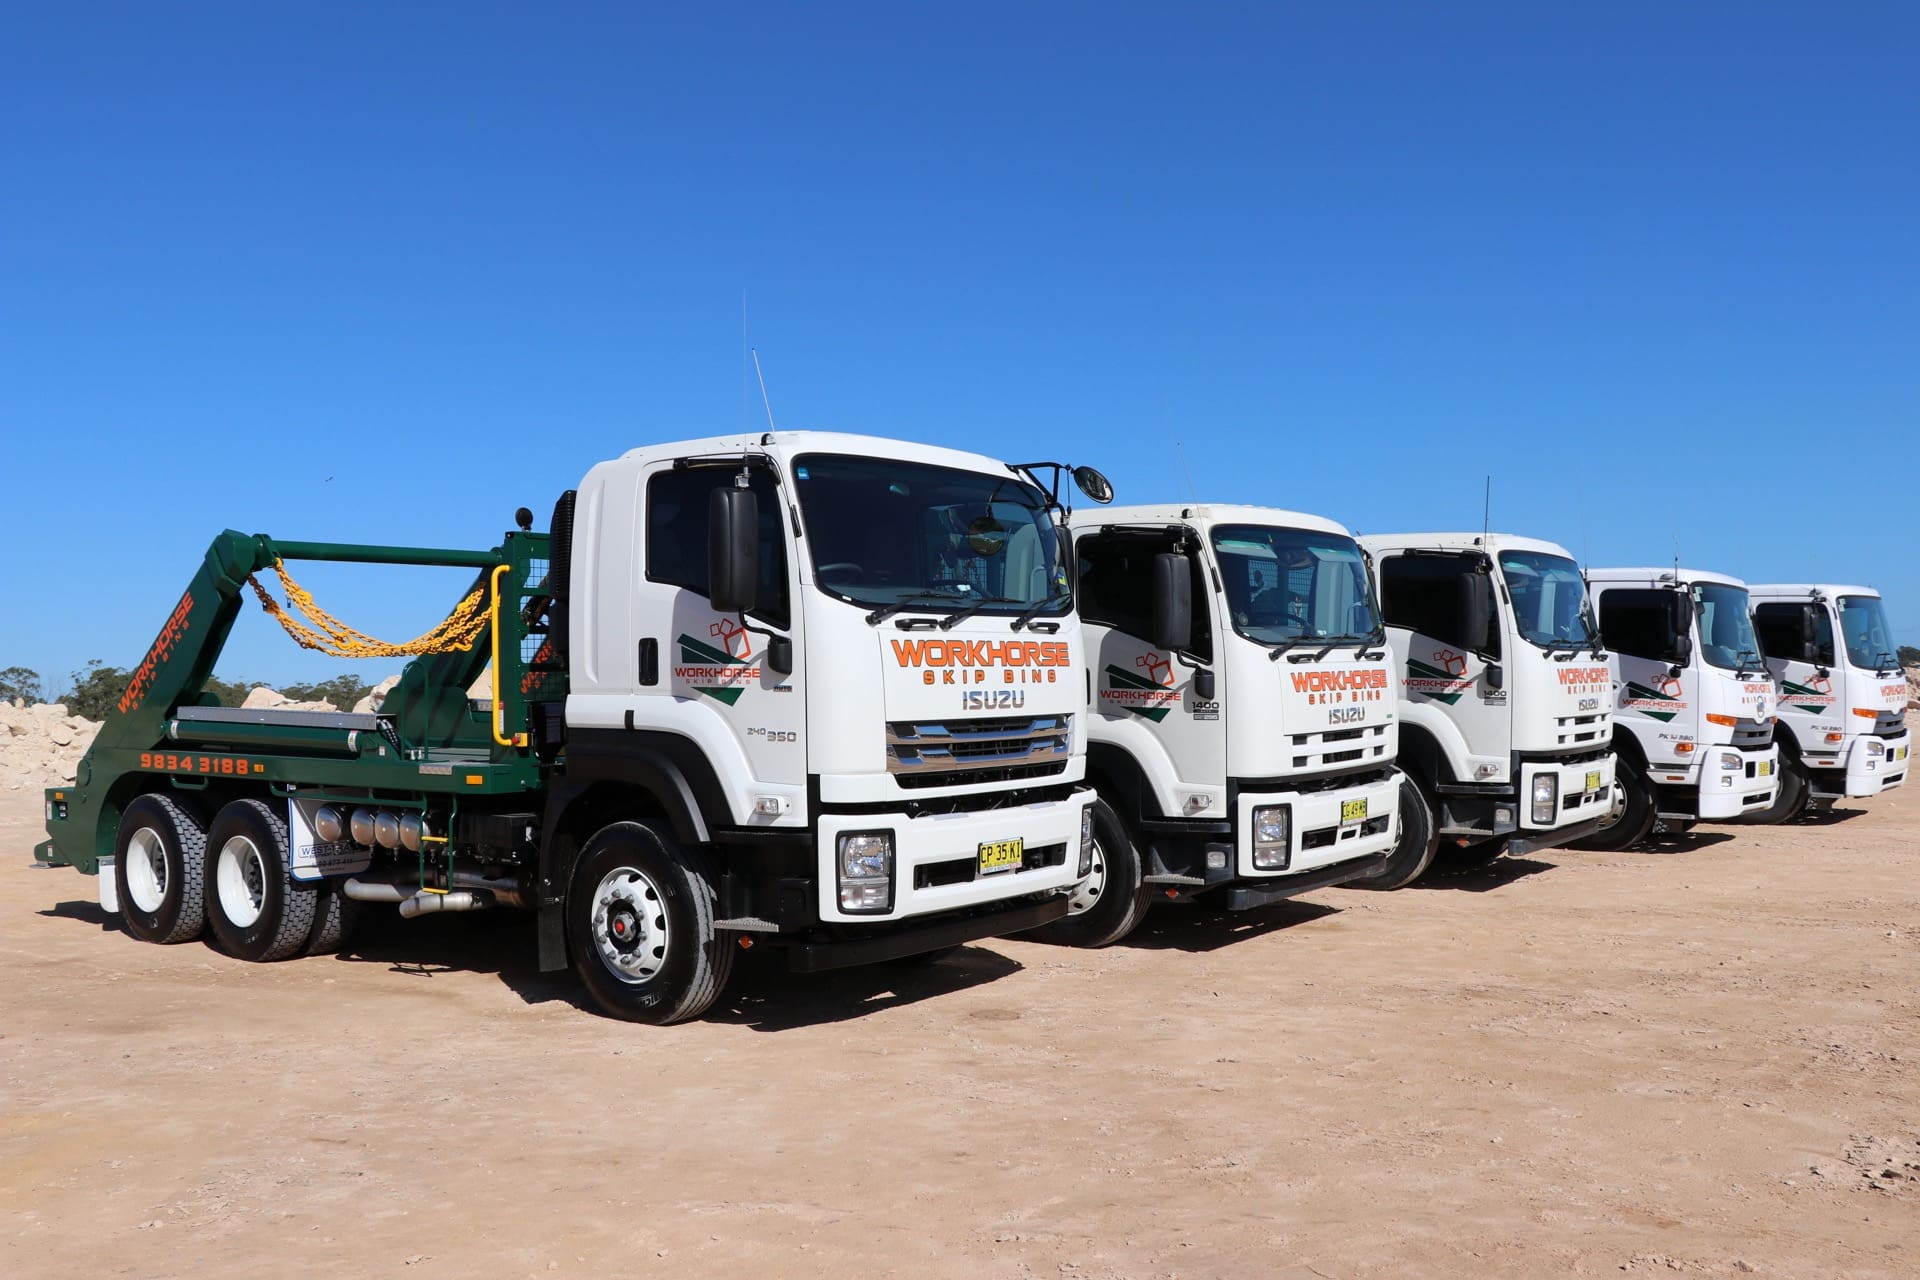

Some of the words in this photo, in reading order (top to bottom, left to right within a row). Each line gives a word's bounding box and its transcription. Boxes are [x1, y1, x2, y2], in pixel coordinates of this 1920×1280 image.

[117, 591, 194, 714] WORKHORSE
[890, 639, 1070, 667] WORKHORSE
[675, 667, 760, 678] WORKHORSE
[923, 669, 985, 685] SKIP
[1004, 669, 1056, 683] BINS
[1290, 669, 1387, 692] WORKHORSE
[1557, 667, 1608, 685] WORKHORSE
[1402, 679, 1473, 689] WORKHORSE
[963, 690, 1025, 710] ISUZU
[1100, 690, 1181, 701] WORKHORSE
[1309, 692, 1342, 705] SKIP
[1352, 690, 1380, 702] BINS
[1622, 699, 1688, 709] WORKHORSE
[1329, 707, 1365, 725] ISUZU
[767, 732, 796, 742] 350
[141, 753, 192, 771] 9834
[200, 757, 248, 775] 3188
[981, 846, 993, 863] CP
[996, 844, 1007, 861] 35
